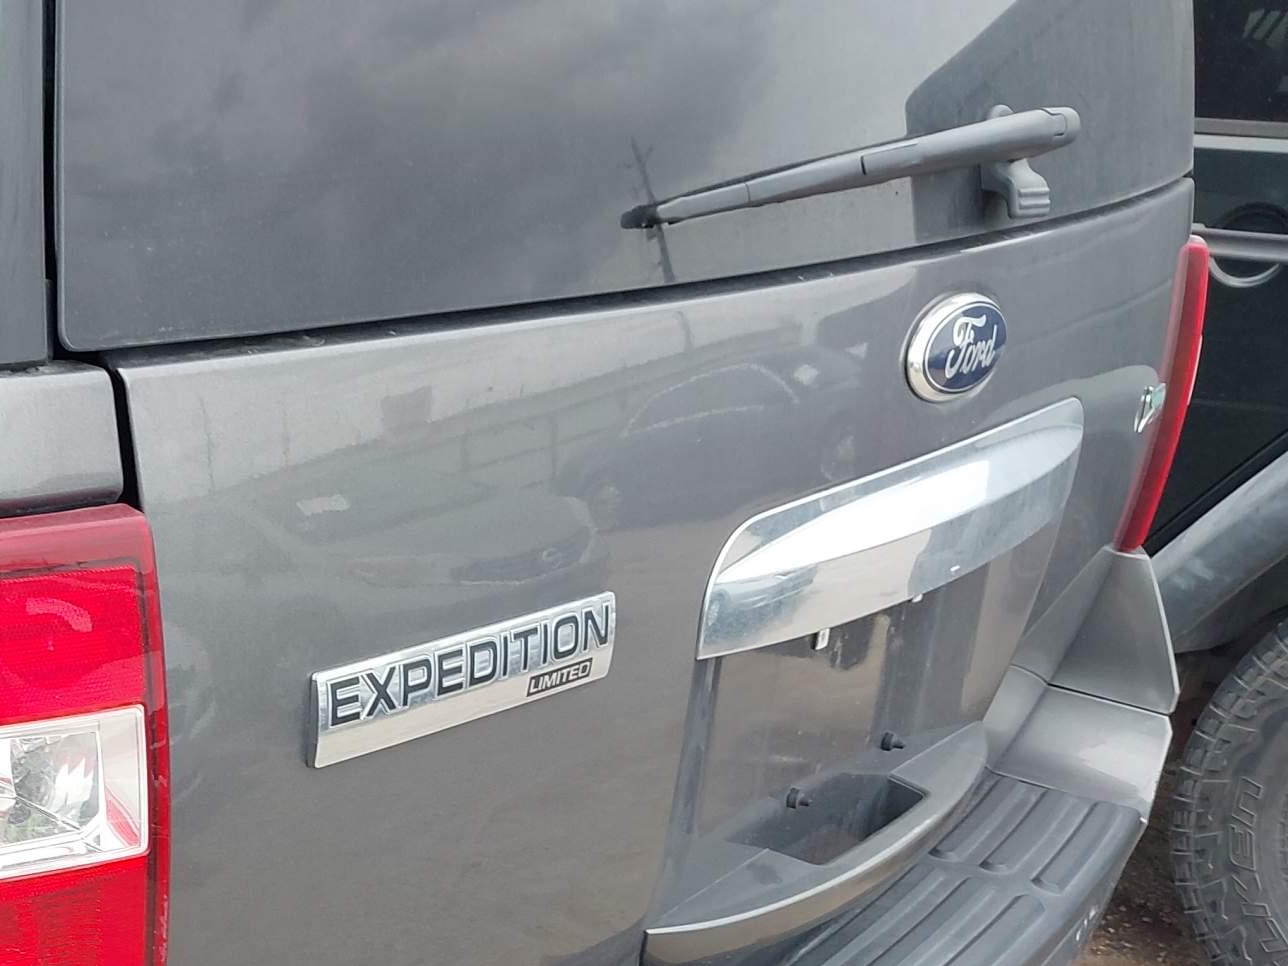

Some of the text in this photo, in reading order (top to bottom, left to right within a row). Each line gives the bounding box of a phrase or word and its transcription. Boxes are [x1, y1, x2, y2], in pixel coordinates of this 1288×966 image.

[945, 315, 998, 378] Ford
[328, 605, 610, 727] EXPEDITION
[528, 661, 590, 693] LIMITED
